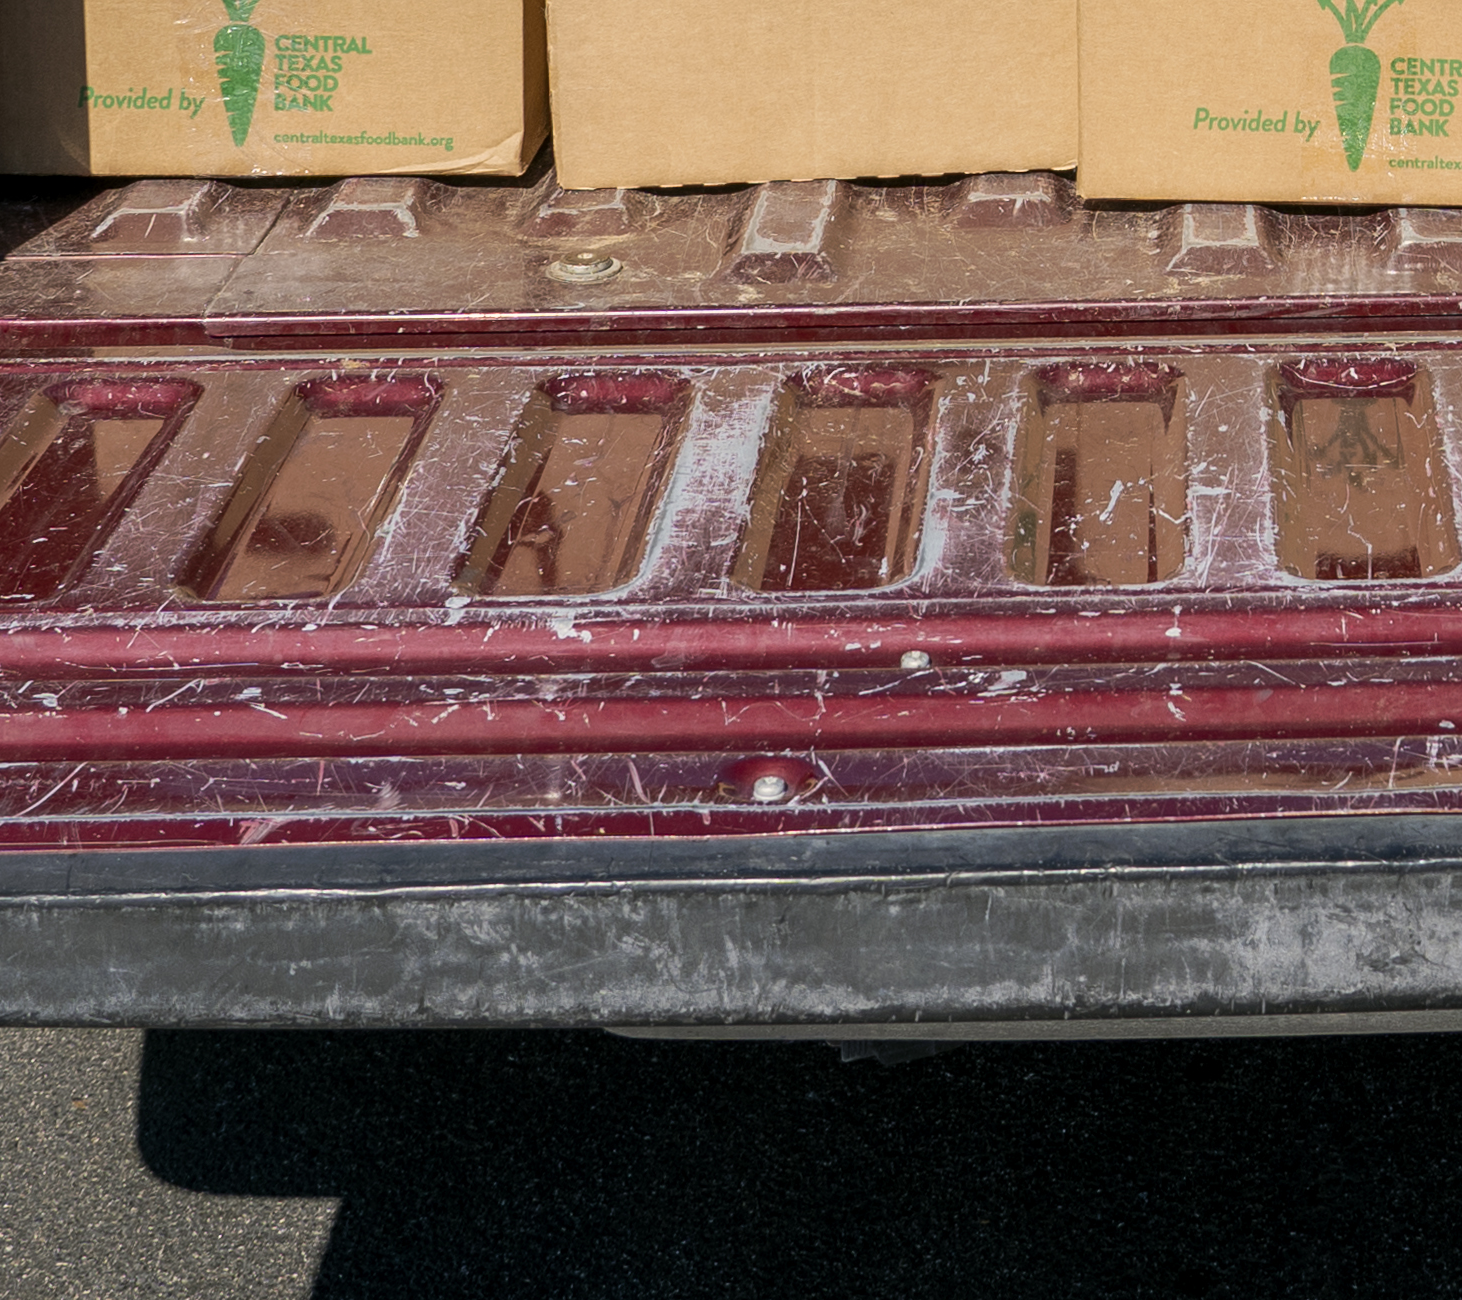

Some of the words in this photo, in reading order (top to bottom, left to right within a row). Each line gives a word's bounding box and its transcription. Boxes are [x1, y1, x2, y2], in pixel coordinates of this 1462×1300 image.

[274, 34, 372, 55] CENTRAL
[274, 55, 343, 73] TEXAS
[274, 74, 339, 92] FOOD
[1390, 77, 1459, 98] TEXAS
[78, 86, 172, 111] Provided
[179, 88, 206, 119] by
[273, 94, 334, 112] BANK
[1390, 98, 1455, 117] FOOD
[1193, 107, 1287, 134] Provided
[1293, 111, 1321, 142] by
[1389, 118, 1450, 138] BANK
[273, 130, 454, 152] centraltexasfoodbank.org
